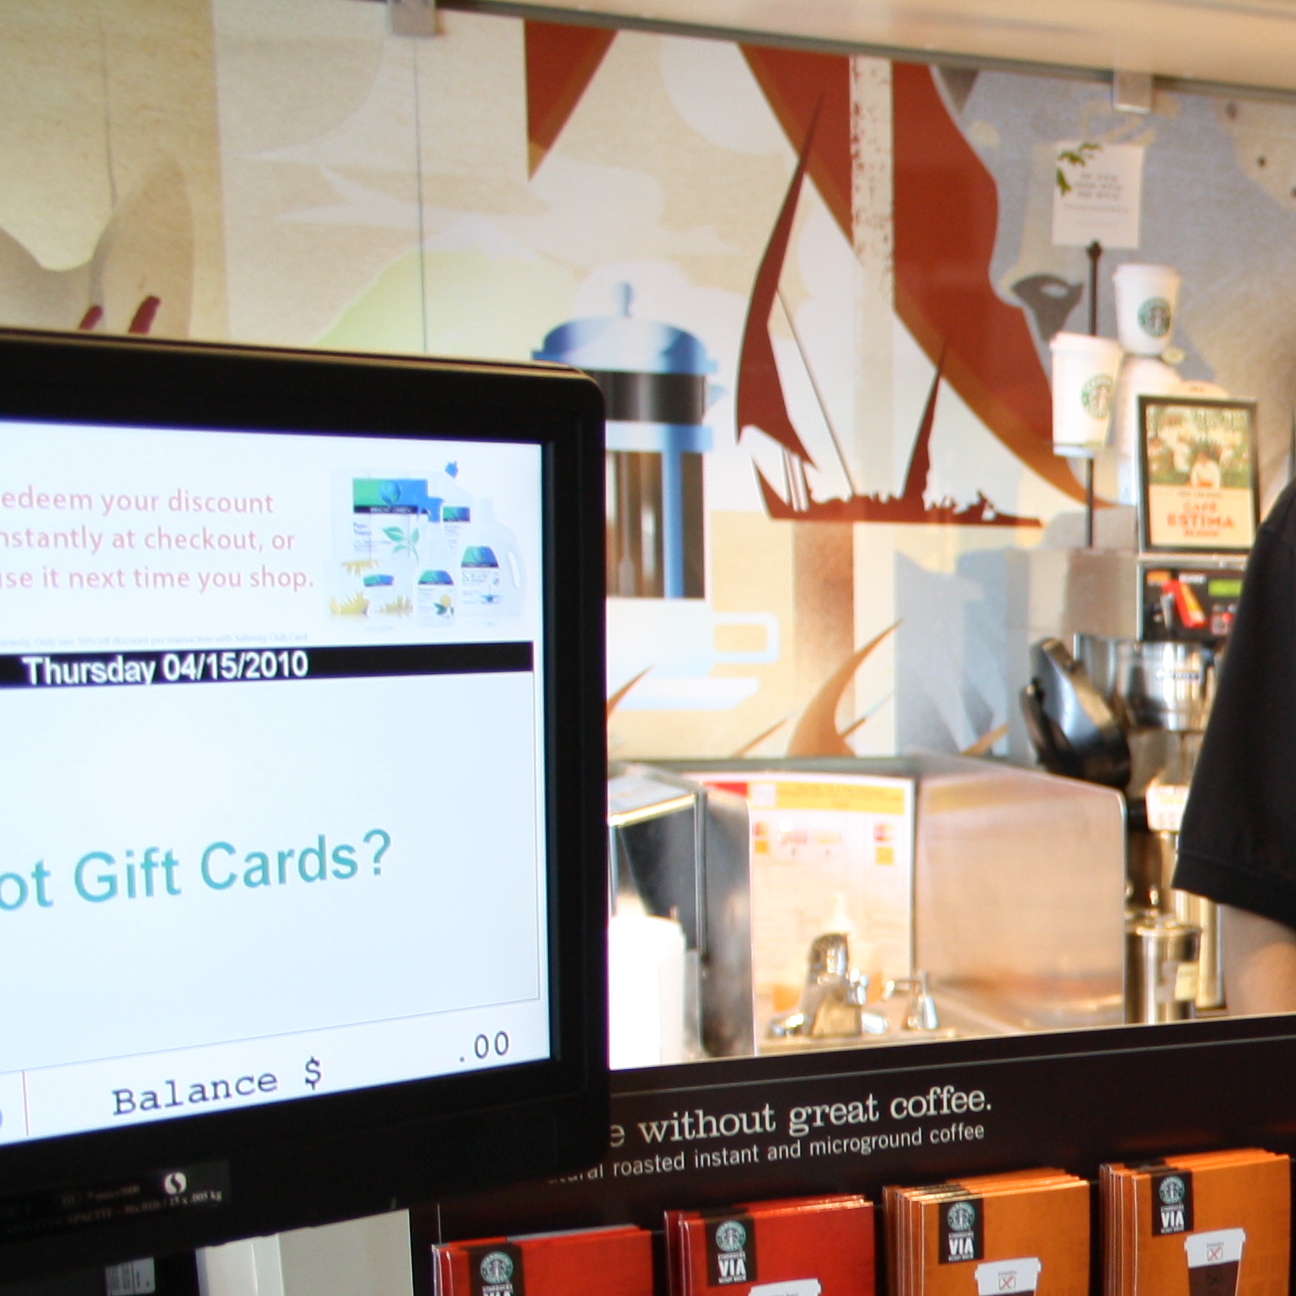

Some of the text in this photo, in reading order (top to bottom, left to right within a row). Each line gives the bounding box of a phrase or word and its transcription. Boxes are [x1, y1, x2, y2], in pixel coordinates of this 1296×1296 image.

[101, 491, 159, 517] your
[168, 488, 275, 515] discount
[111, 530, 136, 550] at
[144, 526, 265, 553] checkout,
[271, 532, 296, 552] or
[42, 565, 60, 588] it
[69, 567, 126, 589] next
[132, 566, 191, 588] time
[198, 570, 242, 594] you
[250, 564, 315, 594] shop.
[21, 650, 310, 687] Thursday 04/15/2010
[74, 846, 182, 903] Gift
[199, 828, 393, 890] Cards?
[112, 1029, 512, 1117] Balance $ .00
[638, 1084, 993, 1146] without great coffee.
[613, 1150, 686, 1178] roasted
[694, 1143, 760, 1169] instant
[768, 1139, 802, 1160] and
[809, 1128, 923, 1158] microground
[929, 1121, 986, 1145] coffee
[1160, 1210, 1185, 1228] VIA
[948, 1236, 974, 1255] VIA
